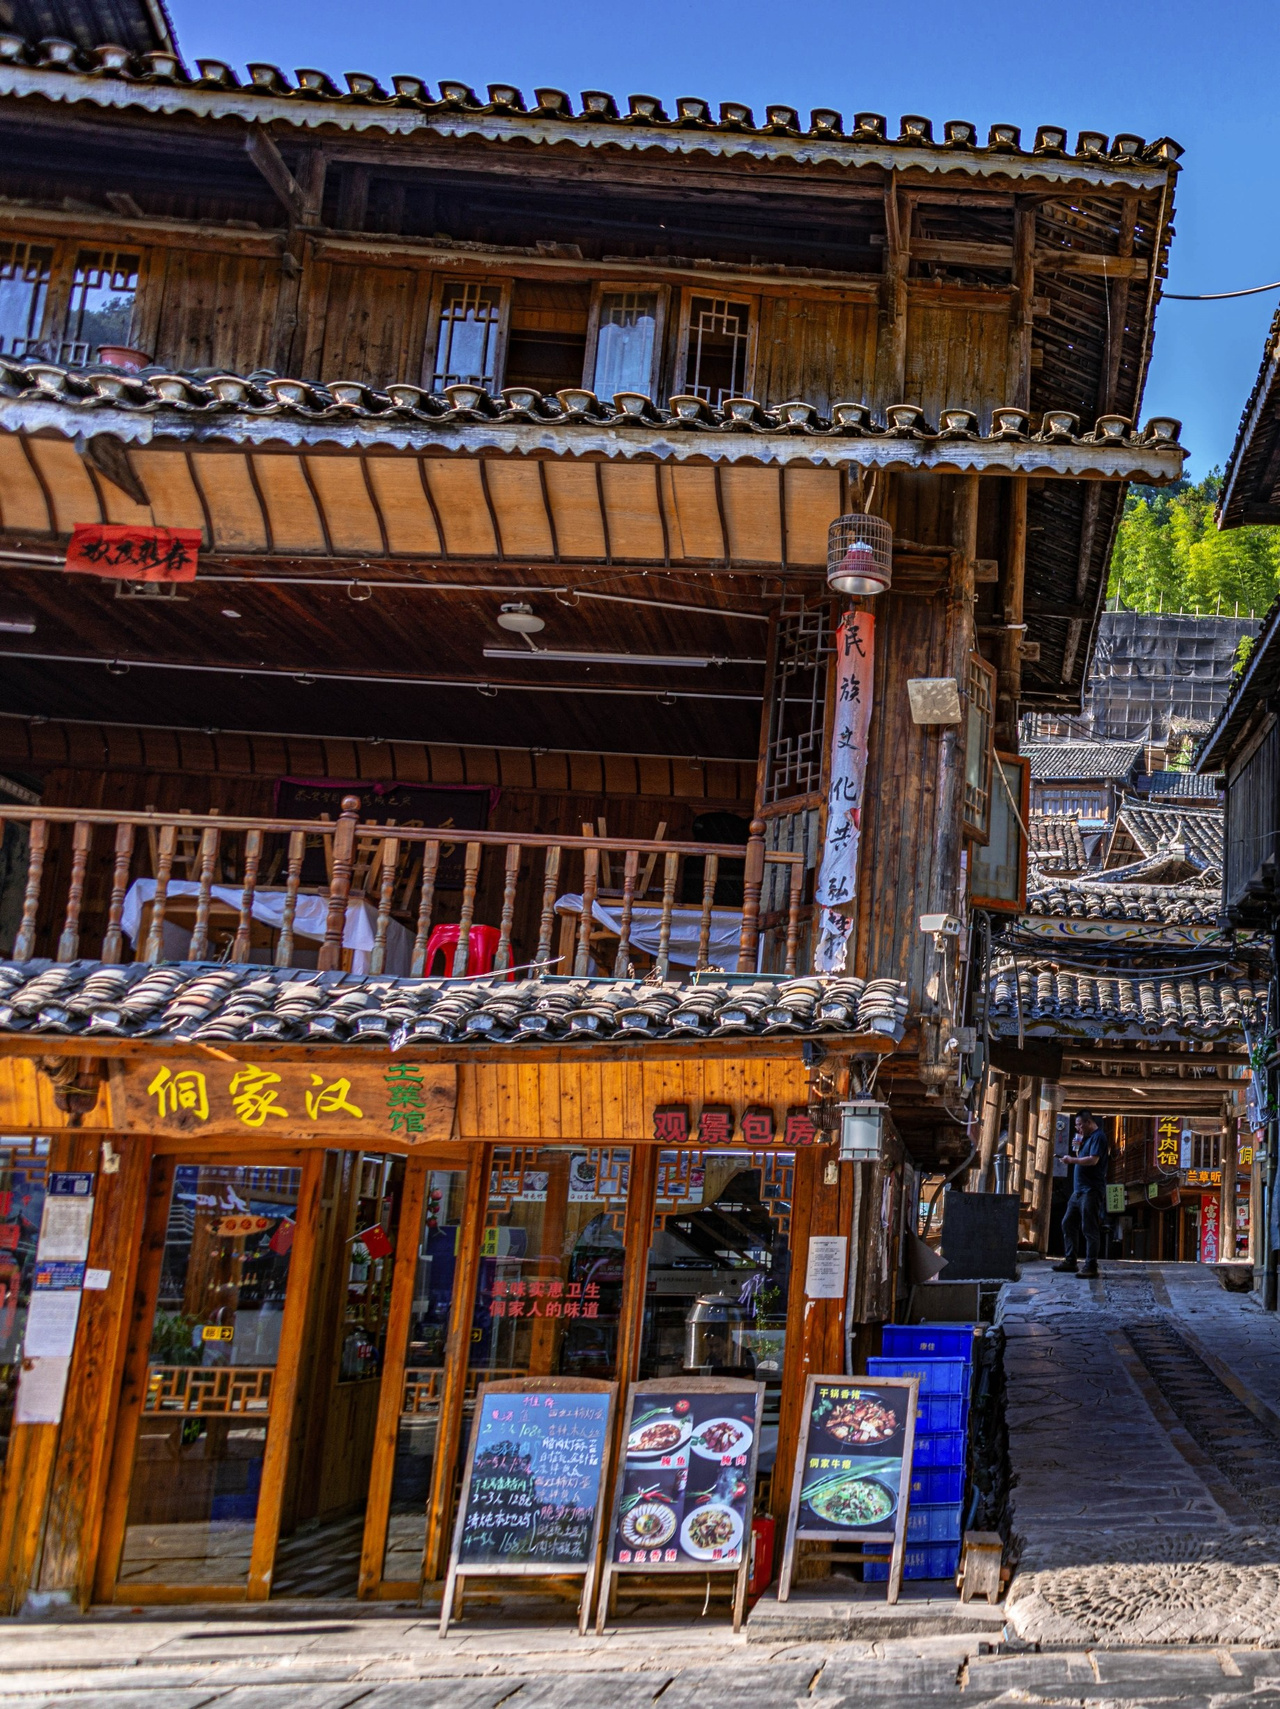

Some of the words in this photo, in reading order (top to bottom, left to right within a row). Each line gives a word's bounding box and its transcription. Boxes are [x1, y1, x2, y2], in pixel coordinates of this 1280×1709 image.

[147, 1063, 363, 1127] 侗家汉
[384, 1063, 426, 1133] 土菜馆
[653, 1110, 818, 1147] 观景包房
[1187, 1170, 1222, 1183] 兰草昕
[491, 1280, 601, 1299] 美味实惠卫生
[489, 1300, 599, 1319] 侗家人的味道
[819, 1388, 862, 1401] 干锅香猪
